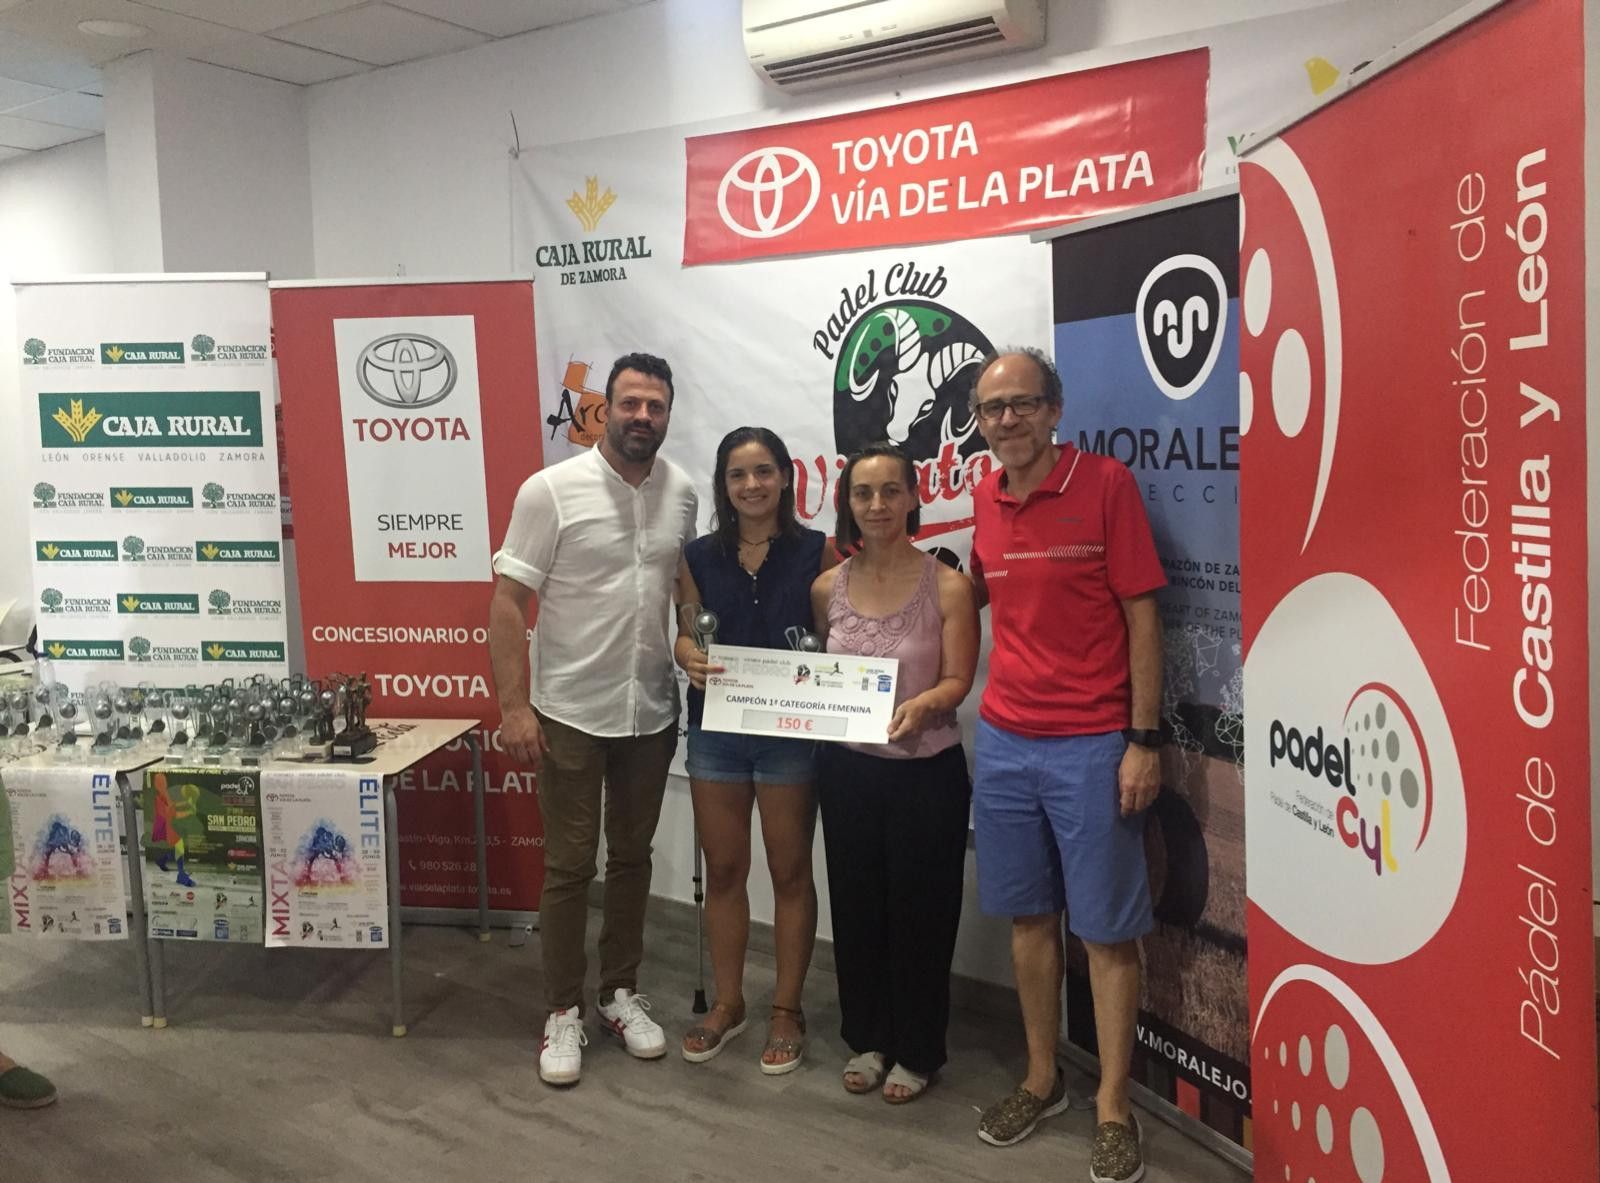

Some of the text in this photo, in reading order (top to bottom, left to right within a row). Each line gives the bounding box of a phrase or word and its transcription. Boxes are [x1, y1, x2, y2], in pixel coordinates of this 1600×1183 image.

[832, 120, 978, 174] TOYOTA
[831, 150, 1154, 225] VÍA DE LA PLATA
[536, 236, 652, 268] CAJA RURAL
[561, 266, 627, 286] DE ZAMORA
[813, 261, 948, 361] Padel Club
[48, 355, 95, 363] CAJA RURAL
[124, 351, 181, 360] CAJA RURAL
[217, 351, 267, 360] CAJA RURAL
[1450, 171, 1491, 652] Federación de
[102, 416, 251, 437] CAJA RURAL
[353, 418, 471, 442] TOYOTA
[1079, 426, 1240, 470] MORALE
[42, 451, 265, 462] LEÓN ORENSE VALLADOLID ZAMORA
[78, 499, 104, 507] RURAL
[133, 496, 189, 504] CAJA RURAL
[227, 500, 246, 508] CAJA
[248, 500, 276, 508] RURAL
[377, 514, 464, 531] SIEMPRE
[59, 549, 114, 558] CAJA RURAL
[146, 553, 193, 561] CAJA RURAL
[219, 549, 275, 558] CAJA RURAL
[388, 542, 457, 558] MEJOR
[1205, 562, 1221, 575] DE
[65, 605, 111, 613] CAJA RURAL
[140, 602, 195, 611] CAJA RURAL
[233, 607, 281, 615] CAJA RURAL
[1505, 147, 1560, 1060] Pádel de Castilla y León
[312, 626, 468, 644] CONCESIONARIO
[66, 649, 121, 658] CAJA RURAL
[225, 649, 281, 658] CAJA RURAL
[375, 674, 490, 698] TOYOTA
[726, 694, 767, 706] CAMPEÓN
[780, 699, 826, 711] CATEGORÍA
[828, 703, 872, 714] FEMENINA
[776, 717, 814, 731] 150 €
[1270, 719, 1356, 796] padel
[422, 769, 460, 792] LA
[207, 815, 256, 827] SAN PEDRO
[1292, 804, 1312, 825] Castilla
[1318, 819, 1334, 837] León
[511, 836, 545, 848] ZAMO
[1336, 796, 1398, 876] cyl
